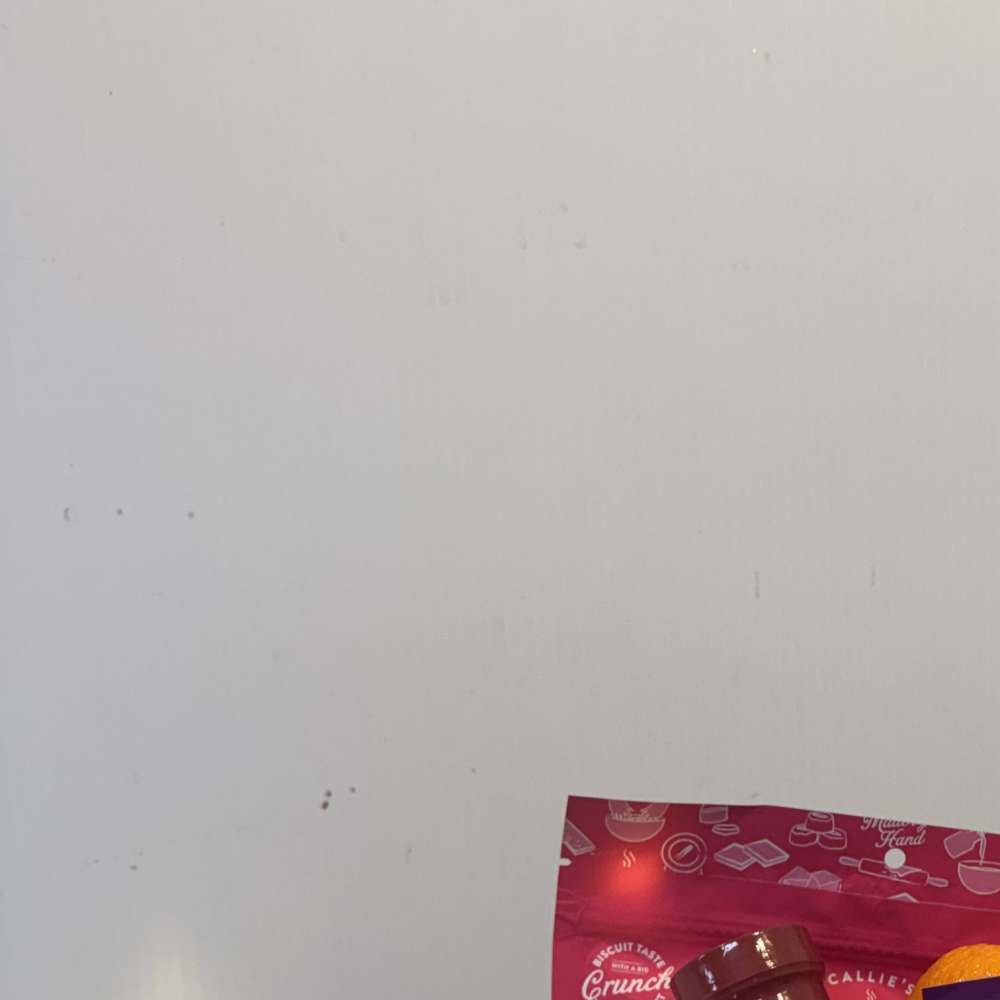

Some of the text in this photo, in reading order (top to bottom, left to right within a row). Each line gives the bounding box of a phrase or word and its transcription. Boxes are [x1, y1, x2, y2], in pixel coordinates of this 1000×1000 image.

[874, 828, 926, 848] Hand
[592, 941, 666, 969] BISCUIT TASTE
[827, 969, 916, 996] CALLIE'S
